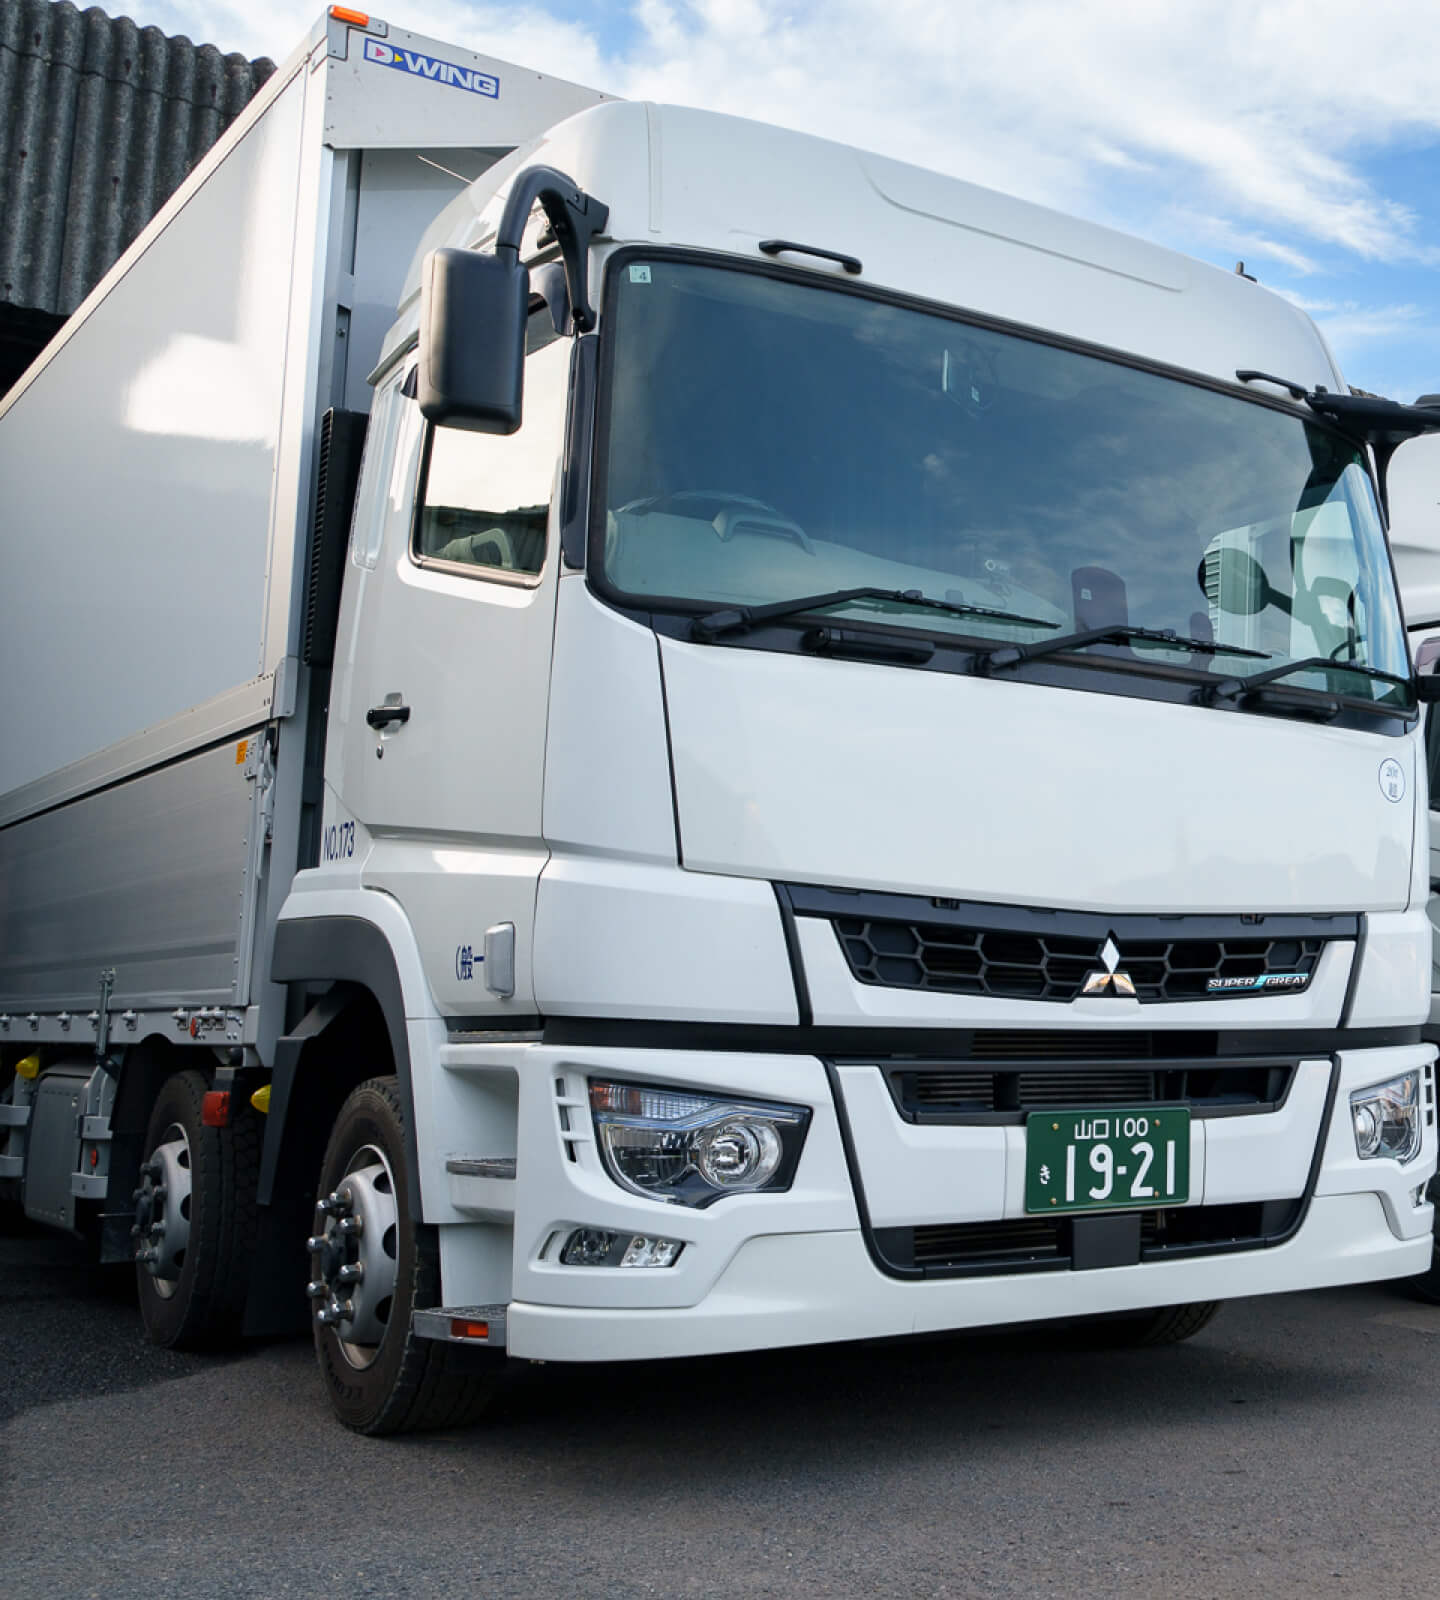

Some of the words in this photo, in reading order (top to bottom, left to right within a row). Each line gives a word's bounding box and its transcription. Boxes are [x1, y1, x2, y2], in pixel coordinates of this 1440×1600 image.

[324, 820, 355, 861] NO.173
[1208, 977, 1255, 987] SUPER
[1265, 976, 1306, 985] GREAT
[1074, 1118, 1110, 1140] 山口
[1115, 1117, 1149, 1139] 100
[1039, 1164, 1051, 1184] き
[1066, 1140, 1176, 1202] 19-21
